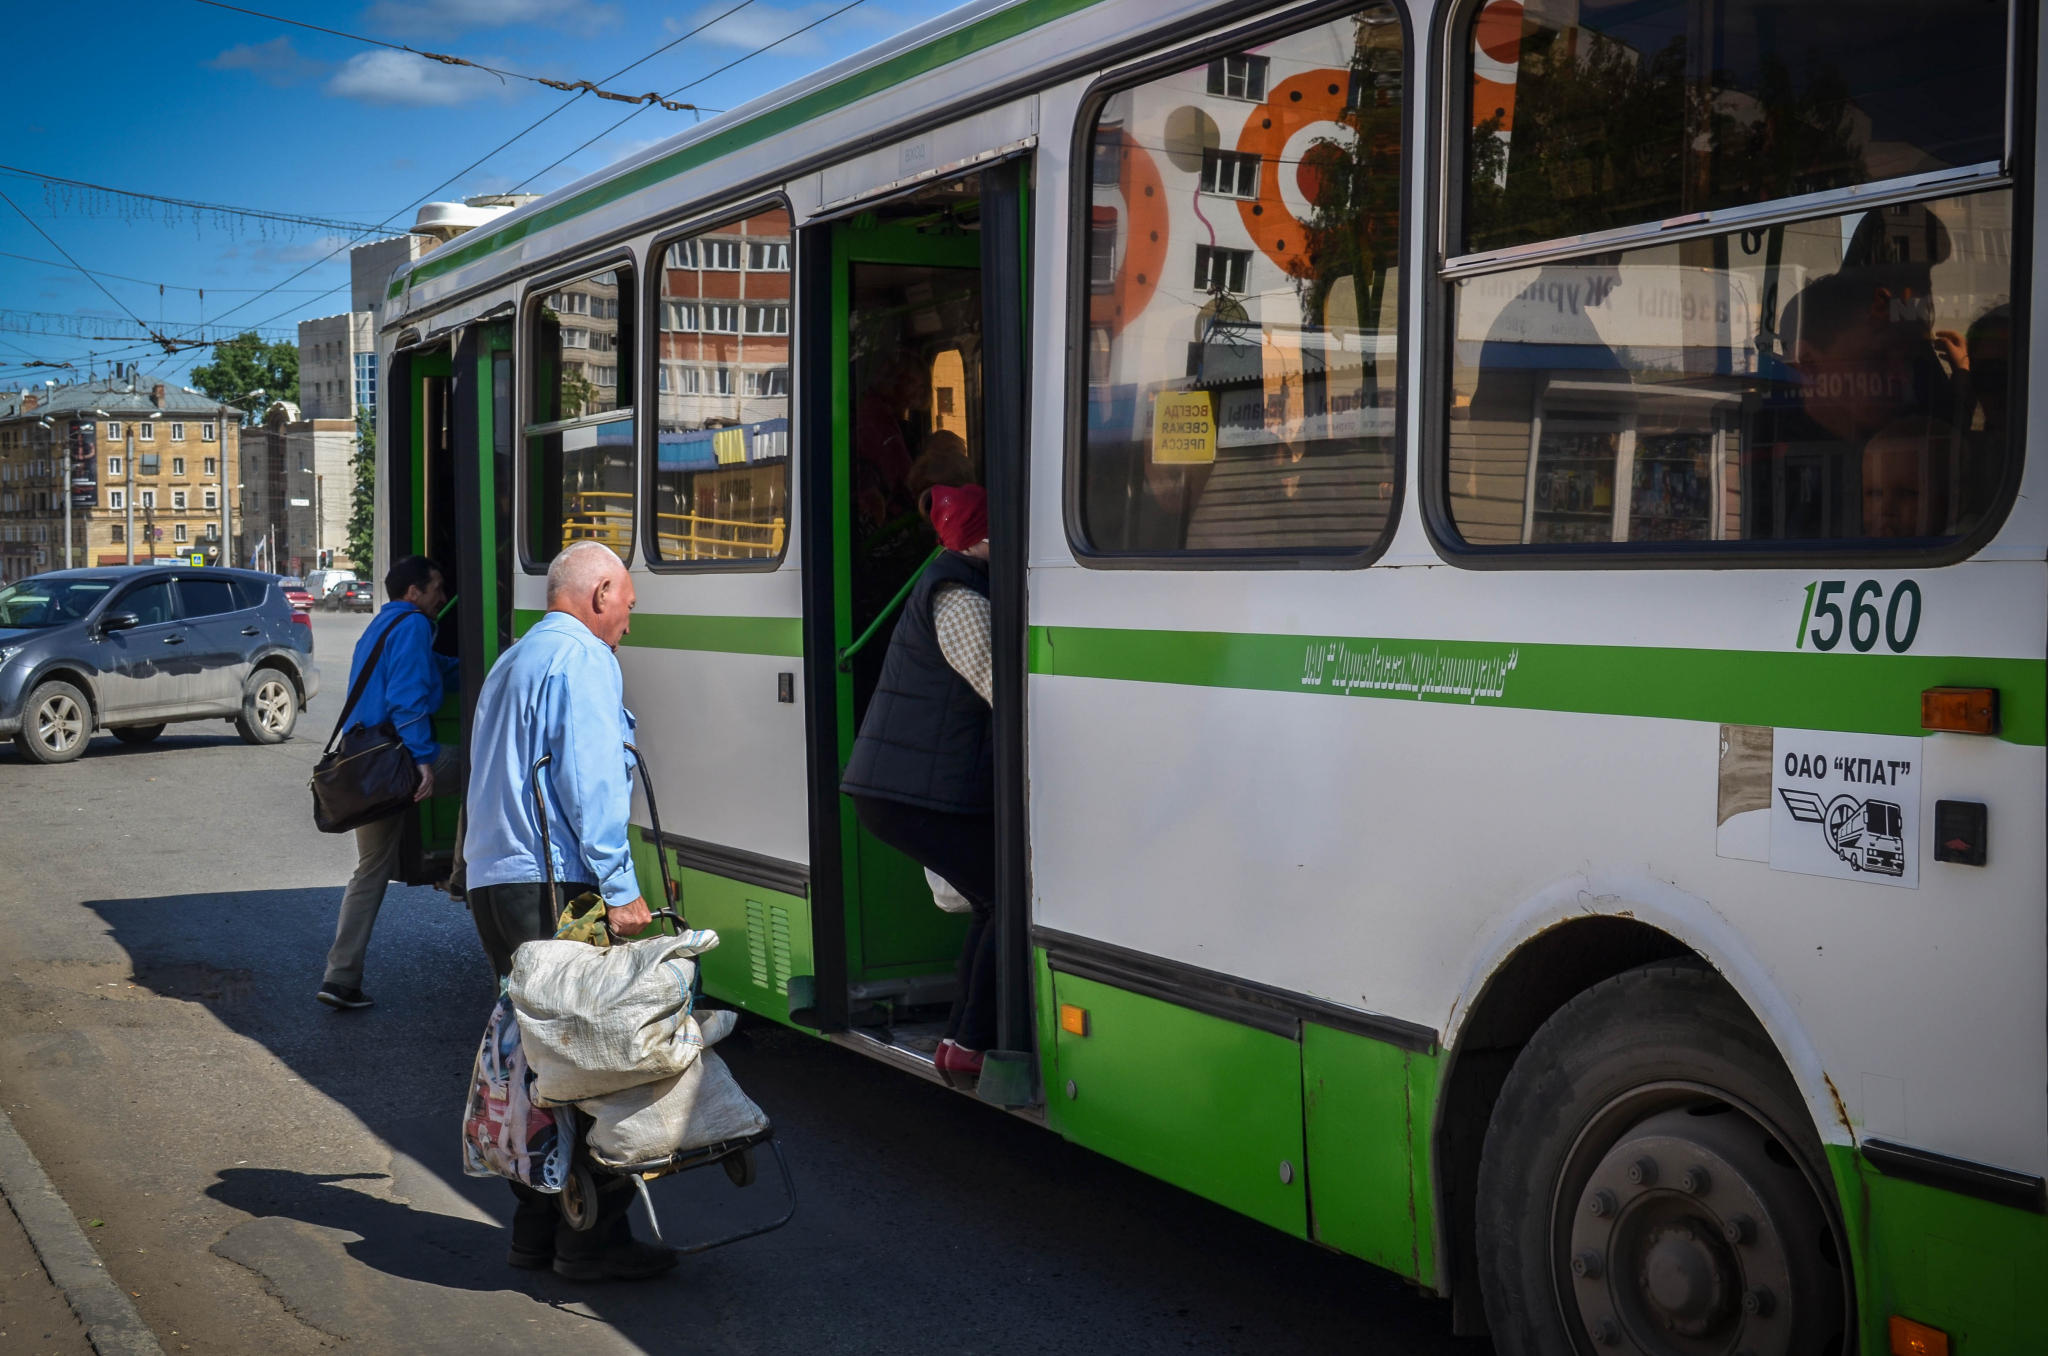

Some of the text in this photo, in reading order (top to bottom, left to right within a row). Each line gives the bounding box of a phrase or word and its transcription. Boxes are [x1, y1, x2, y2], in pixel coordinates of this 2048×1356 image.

[905, 143, 926, 163] ВХОД
[1796, 578, 1922, 653] 1560
[1784, 752, 1828, 780] ОАО
